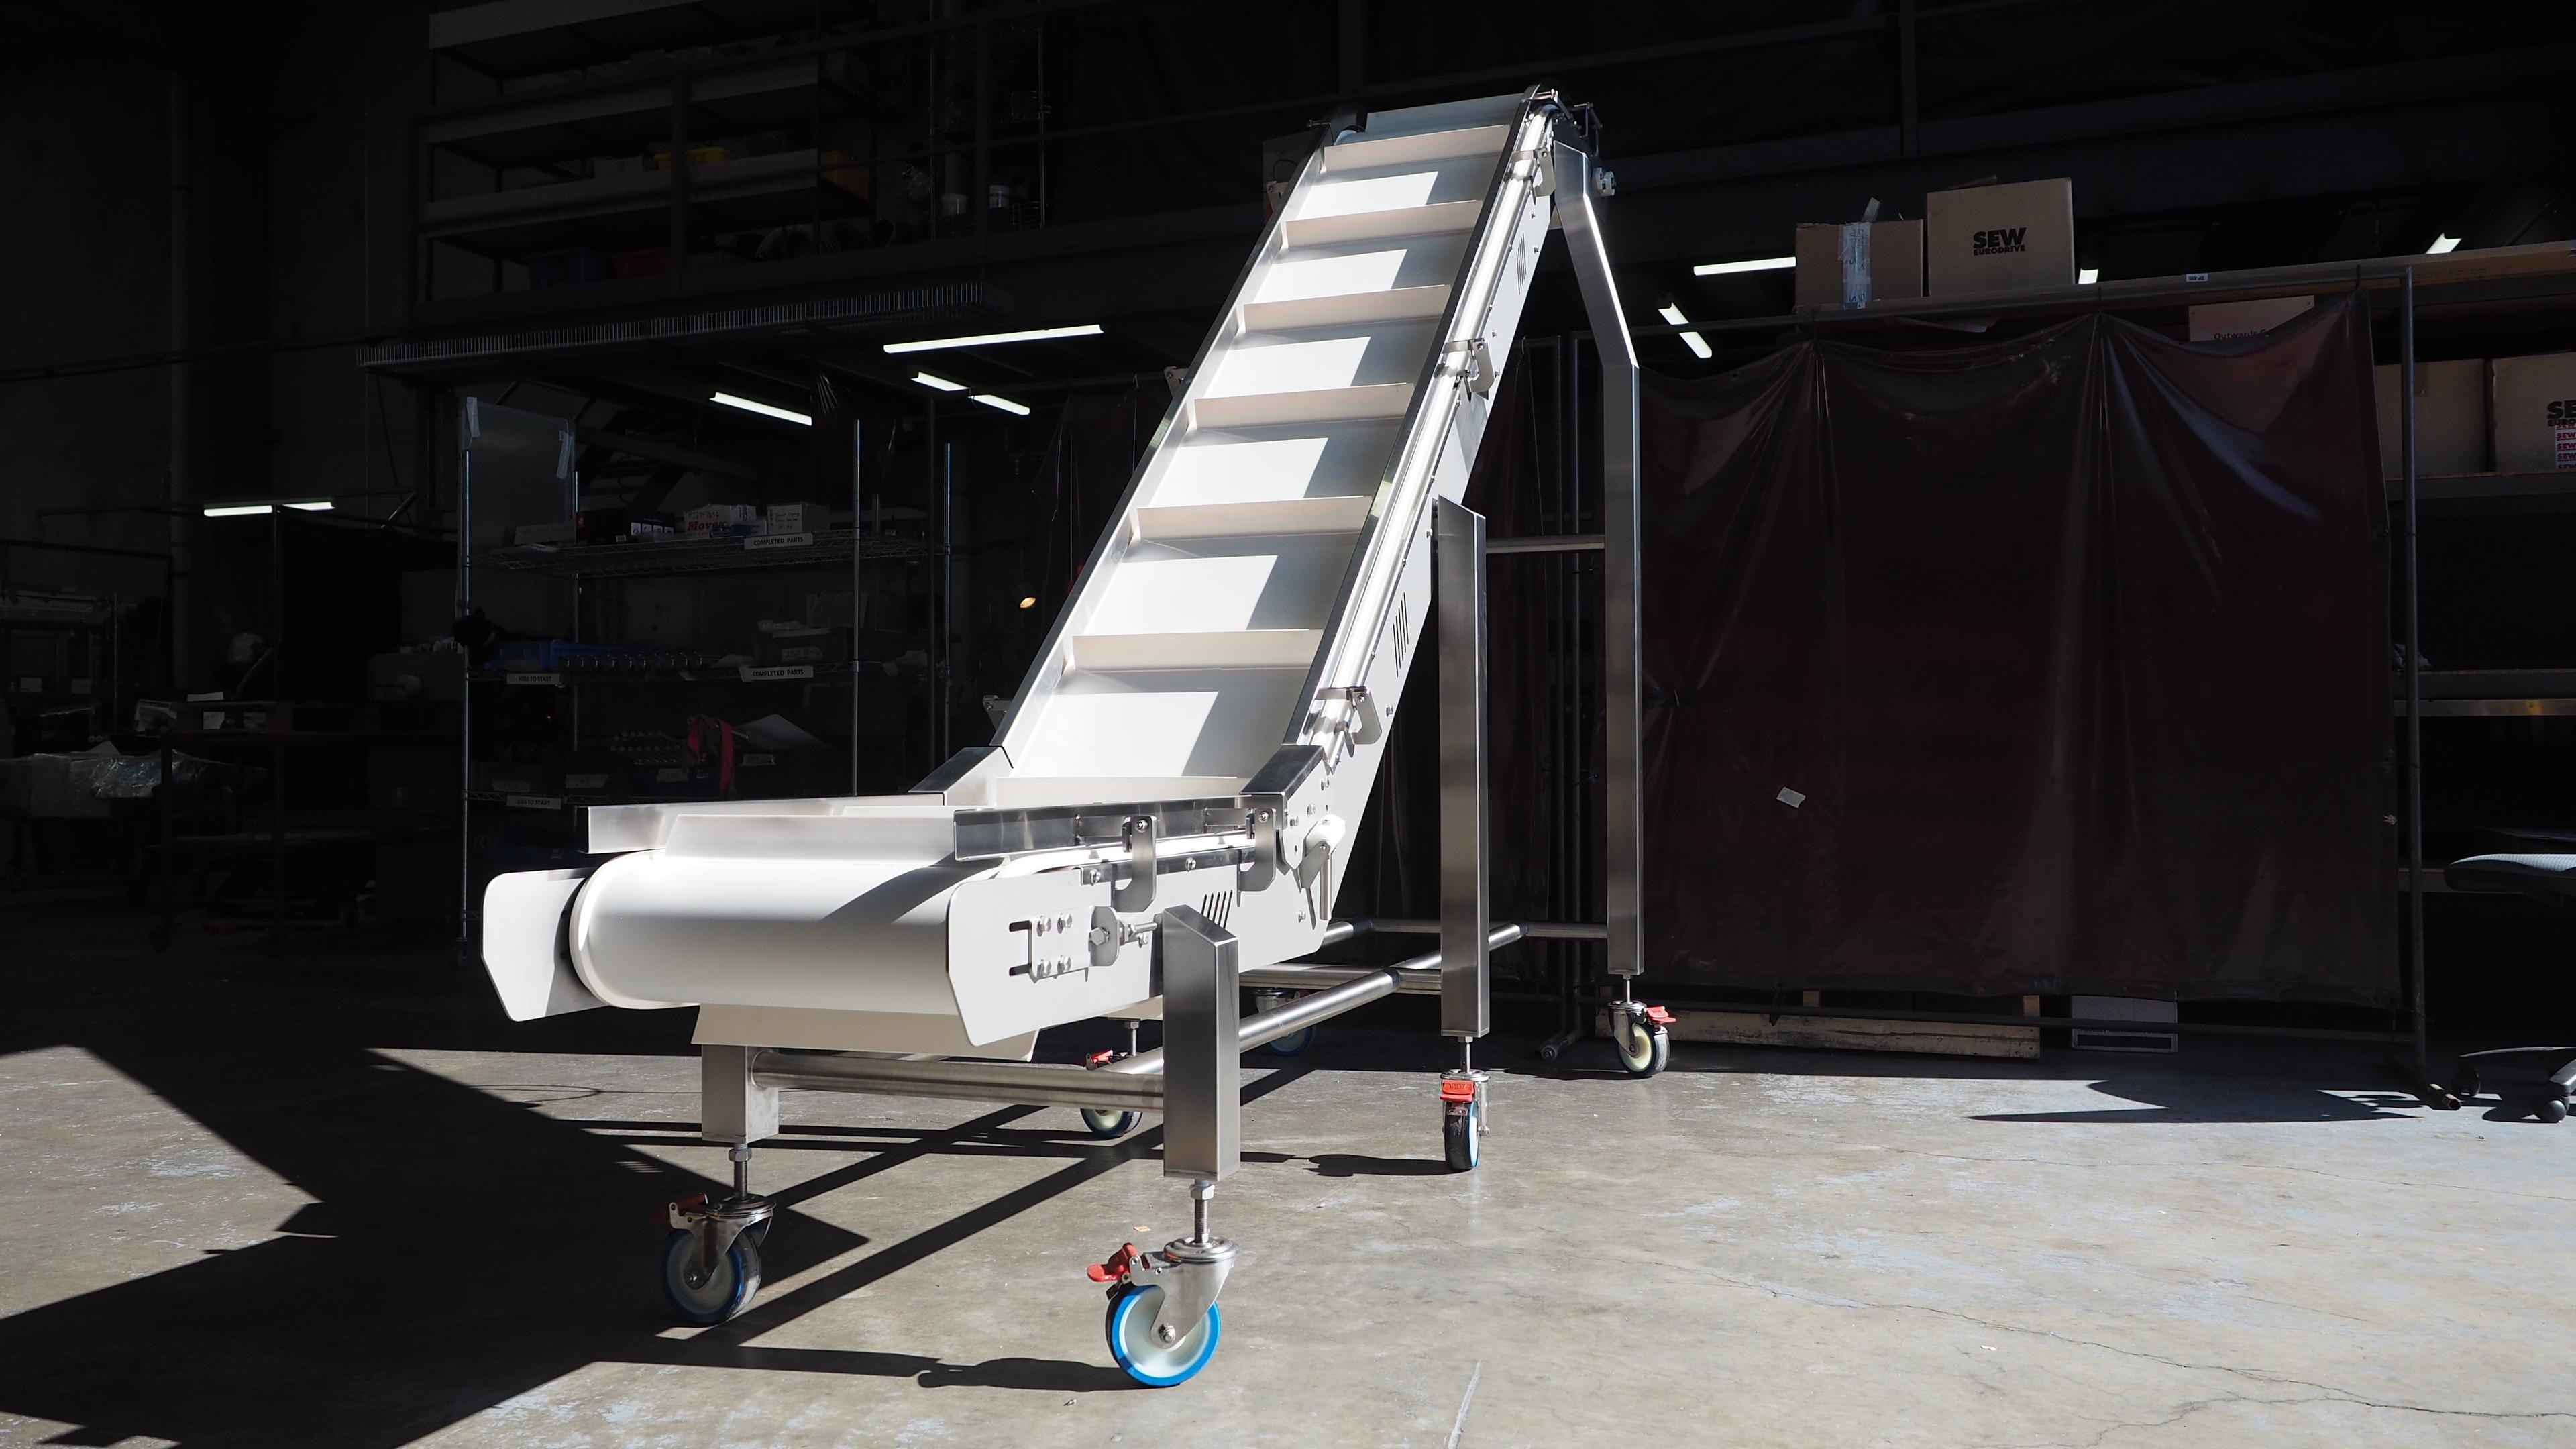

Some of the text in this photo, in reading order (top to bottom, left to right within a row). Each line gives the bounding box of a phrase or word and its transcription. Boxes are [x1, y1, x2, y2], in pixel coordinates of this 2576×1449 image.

[1974, 227, 2027, 248] SEW
[1974, 245, 2025, 256] EURODRIVE
[753, 537, 784, 546] COMPLETED
